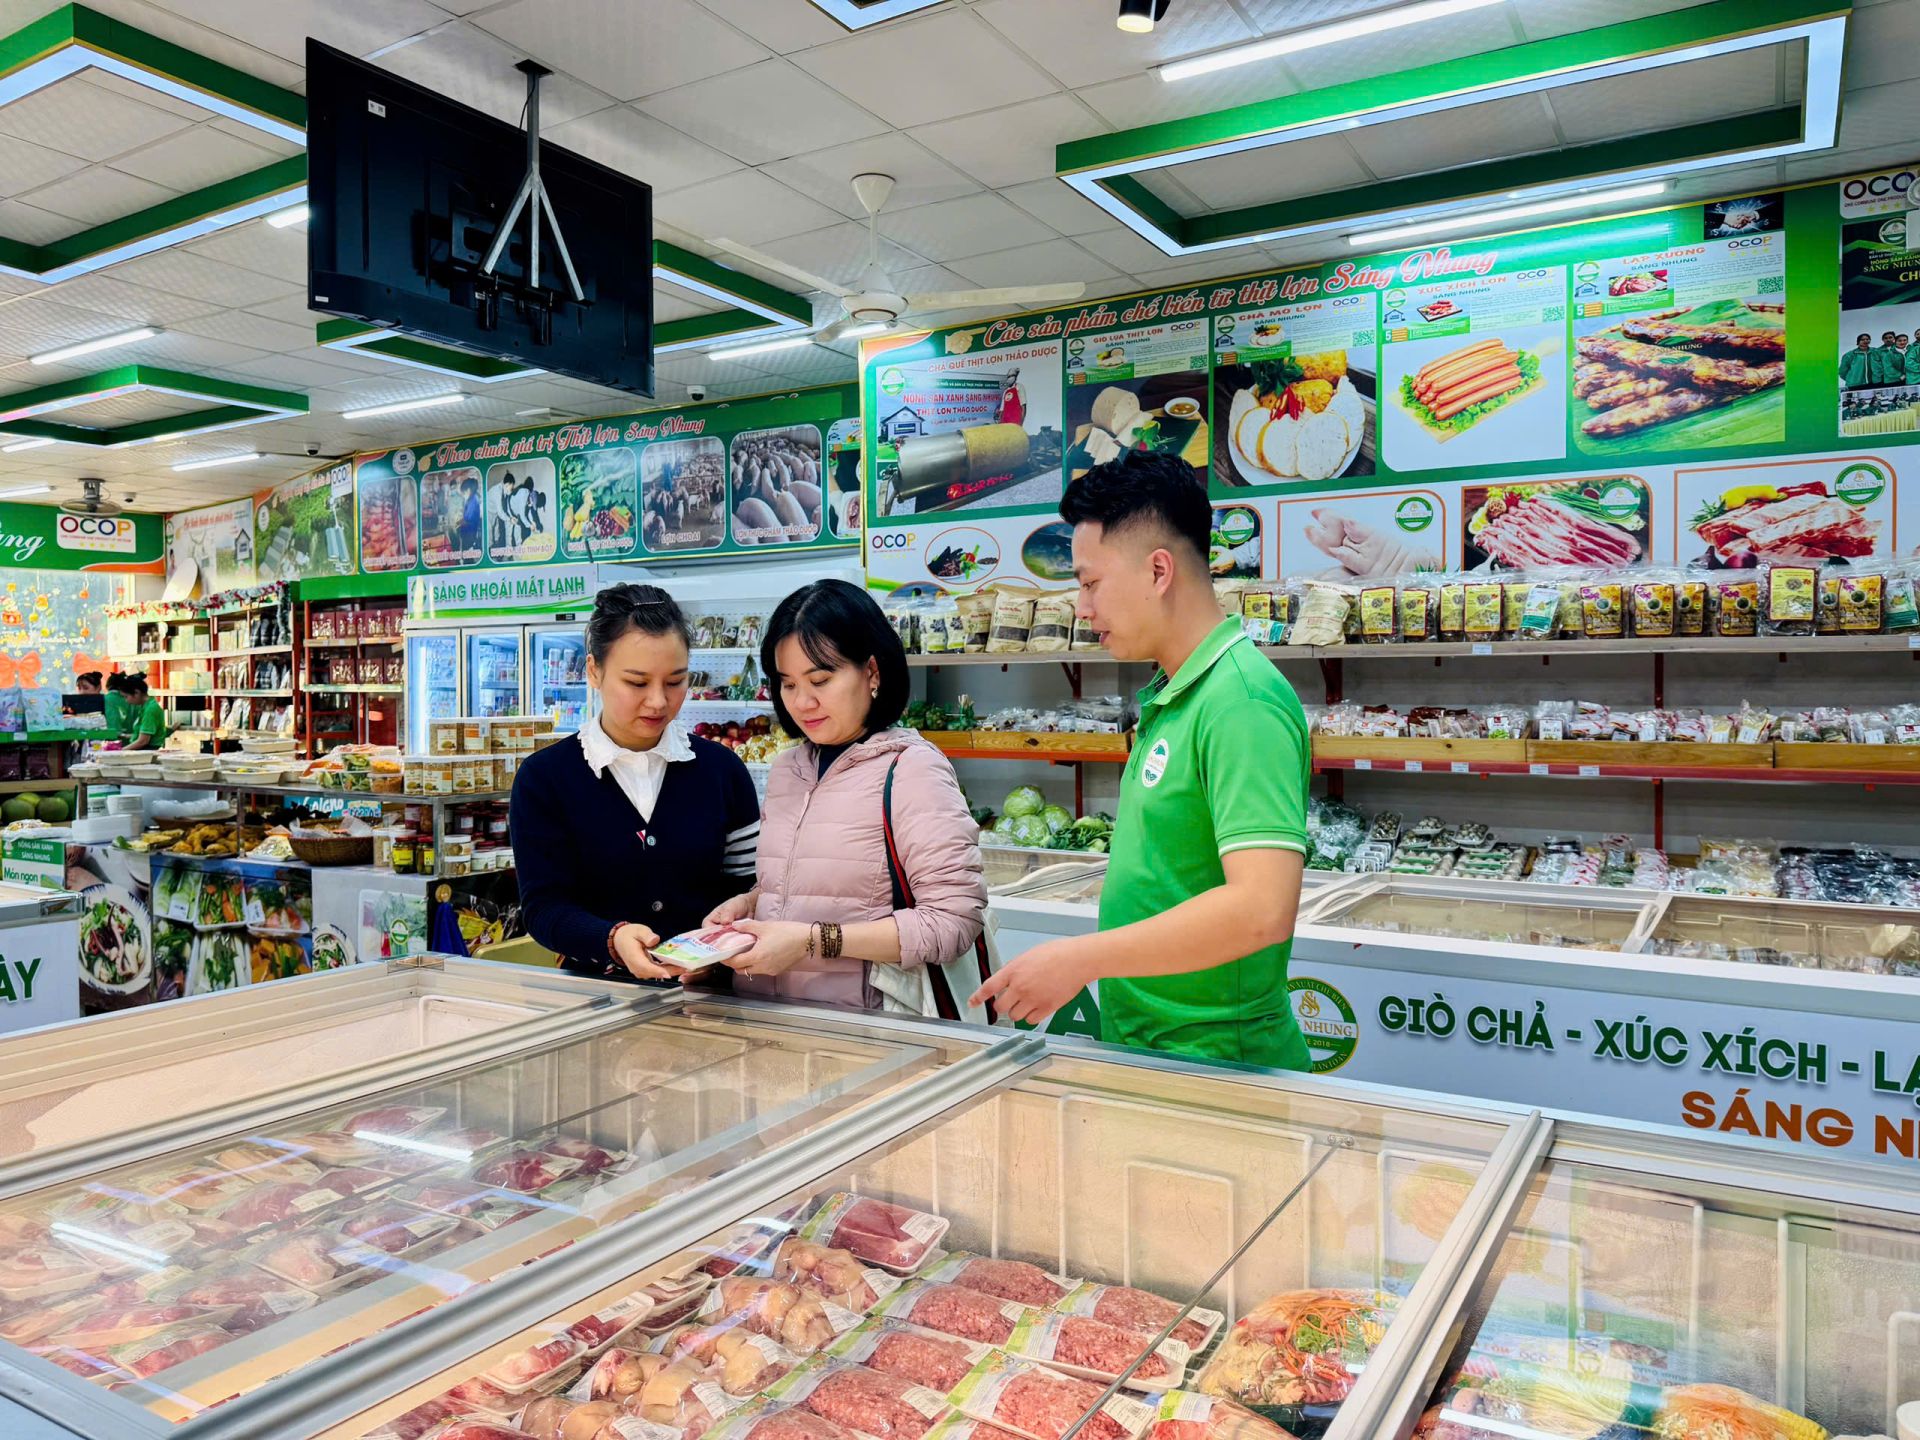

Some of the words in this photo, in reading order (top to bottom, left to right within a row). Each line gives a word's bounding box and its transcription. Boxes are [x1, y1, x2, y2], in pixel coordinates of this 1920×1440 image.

[1843, 171, 1917, 200] OCO
[1728, 236, 1772, 249] OCOP
[1892, 259, 1920, 269] NHUN
[1899, 270, 1920, 282] CH
[984, 319, 1026, 348] Các
[1028, 310, 1062, 337] sản
[1063, 306, 1117, 338] phẩm
[1122, 297, 1162, 324] chế
[1163, 290, 1206, 317] biến
[1209, 286, 1237, 311] từ
[1237, 280, 1279, 306] thịt
[1280, 275, 1319, 301] lợn
[1323, 262, 1395, 293] Sáng
[1400, 247, 1498, 284] Nhung
[1170, 321, 1200, 332] OCOP
[946, 393, 964, 403] XANH
[436, 442, 472, 466] Theo
[474, 437, 510, 460] chuỗi
[511, 435, 536, 458] giá
[536, 432, 554, 455] trị
[556, 423, 592, 450] Thịt
[593, 423, 620, 445] lợn
[624, 420, 658, 442] Sáng
[660, 415, 706, 435] Nhung
[60, 516, 131, 537] OCOP
[871, 532, 917, 550] OCOP
[471, 576, 513, 600] KHOÁI
[517, 576, 545, 598] MÁT
[548, 576, 585, 600] LẠNH
[4, 866, 20, 880] Món
[20, 872, 39, 885] ngon
[1303, 1020, 1352, 1037] NHUNG
[1378, 992, 1456, 1038] GIÒ
[1466, 1000, 1555, 1050] CHẢ
[1566, 1028, 1582, 1040] -
[1593, 1014, 1688, 1067] XÚC
[1700, 1026, 1827, 1084] XÍCH
[1841, 1060, 1860, 1073] -
[1874, 1049, 1920, 1110] LẠ
[1681, 1087, 1854, 1148] SÁNG
[1874, 1114, 1920, 1160] N
